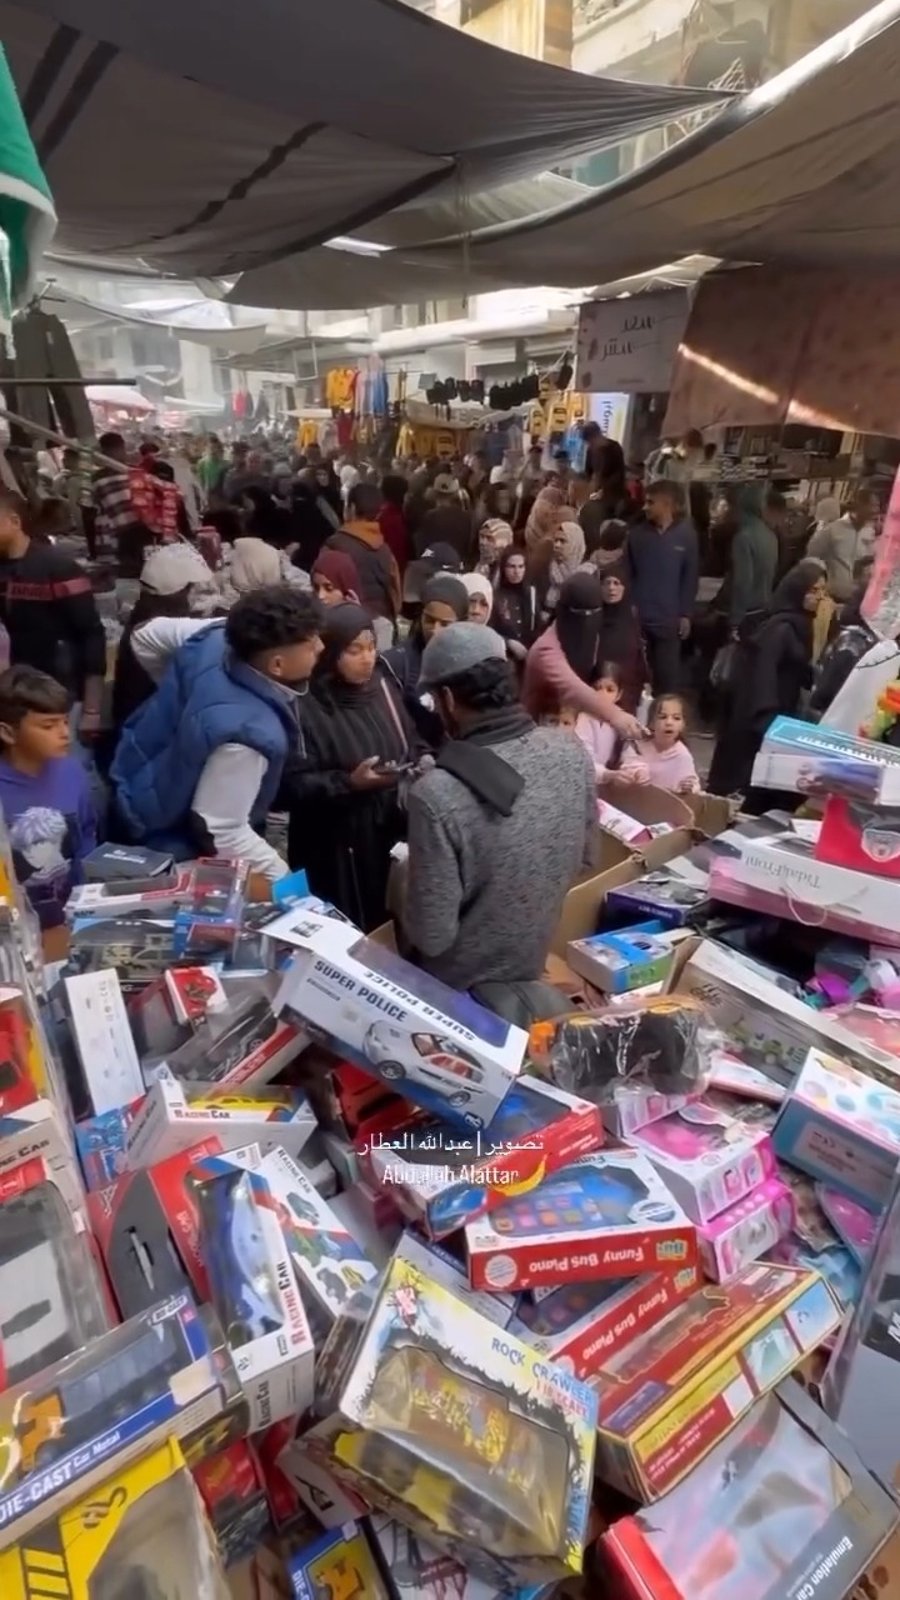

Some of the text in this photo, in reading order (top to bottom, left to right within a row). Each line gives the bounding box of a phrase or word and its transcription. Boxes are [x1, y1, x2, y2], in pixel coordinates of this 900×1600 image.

[313, 960, 355, 991] SUPER
[357, 985, 409, 1023] POLICE
[363, 971, 418, 1008] POLICE
[422, 1006, 475, 1043] SUPER
[529, 1256, 568, 1272] Piano
[570, 1252, 599, 1267] Bus
[602, 1247, 645, 1263] Funny
[582, 1287, 668, 1359] Funny Bus Piano
[491, 1337, 526, 1367] ROCK
[810, 1535, 854, 1585] Emulation
